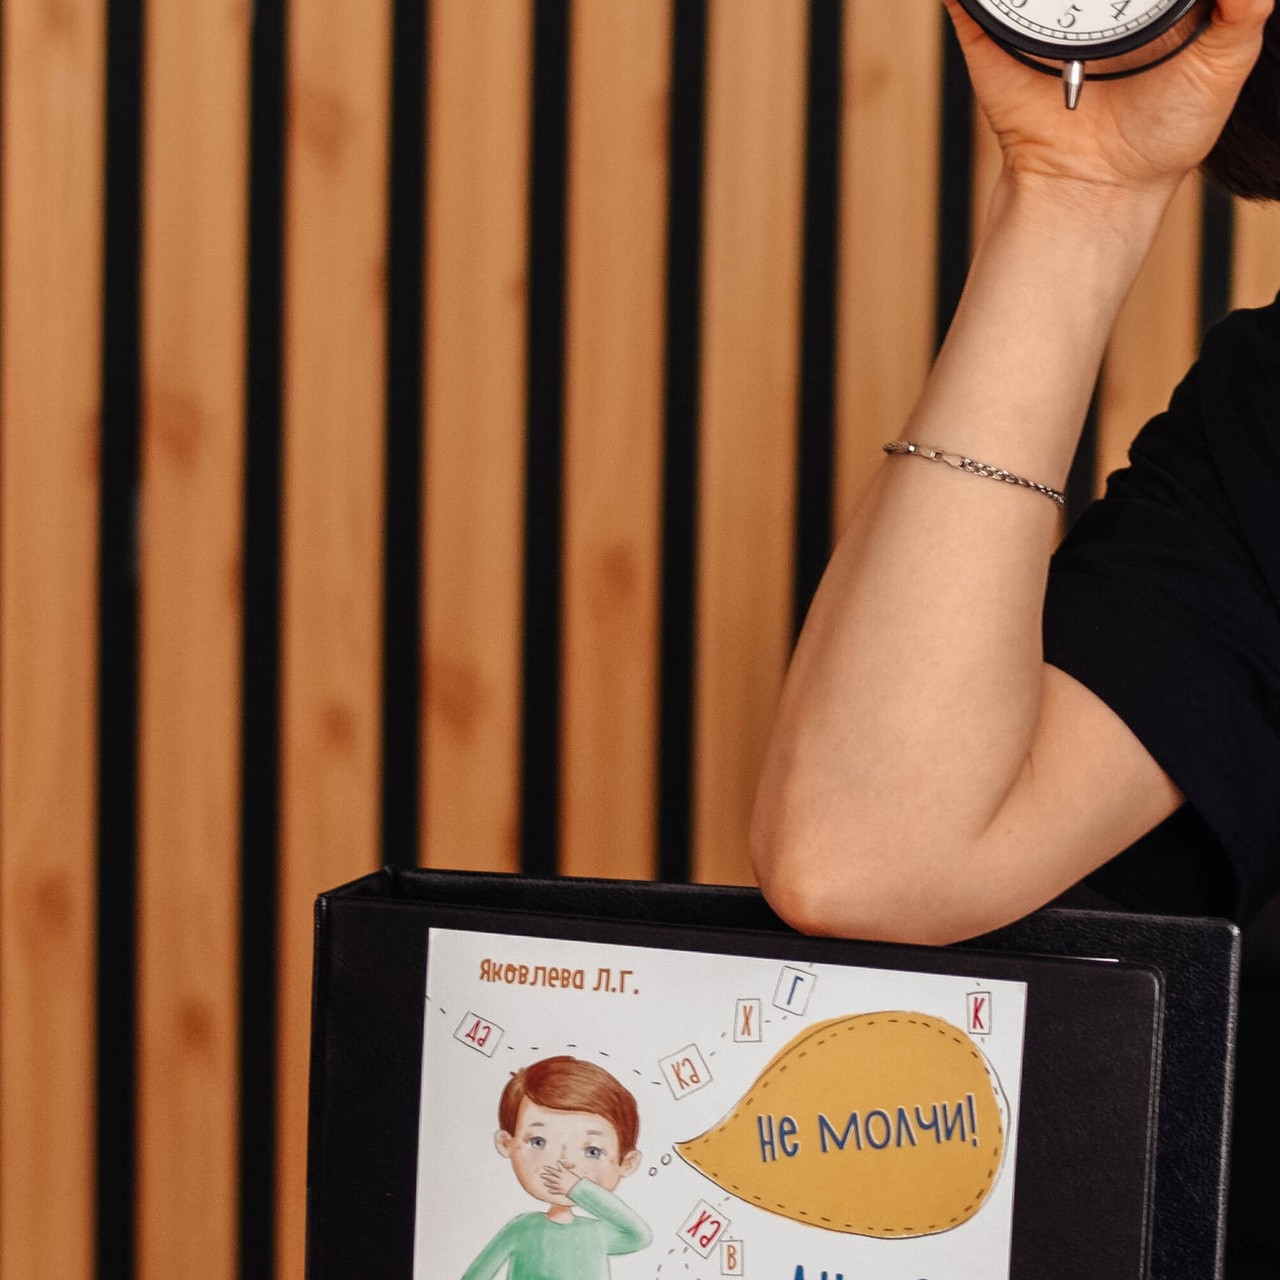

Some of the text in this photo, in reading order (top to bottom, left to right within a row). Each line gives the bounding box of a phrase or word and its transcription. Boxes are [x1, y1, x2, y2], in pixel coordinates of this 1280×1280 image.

[1057, 4, 1082, 28] 5
[1110, 0, 1132, 21] 4
[479, 958, 640, 995] Яковлева Л.Г.
[786, 975, 804, 1005] Г
[740, 1004, 753, 1036] Х
[972, 997, 985, 1030] К
[727, 1244, 737, 1270] В
